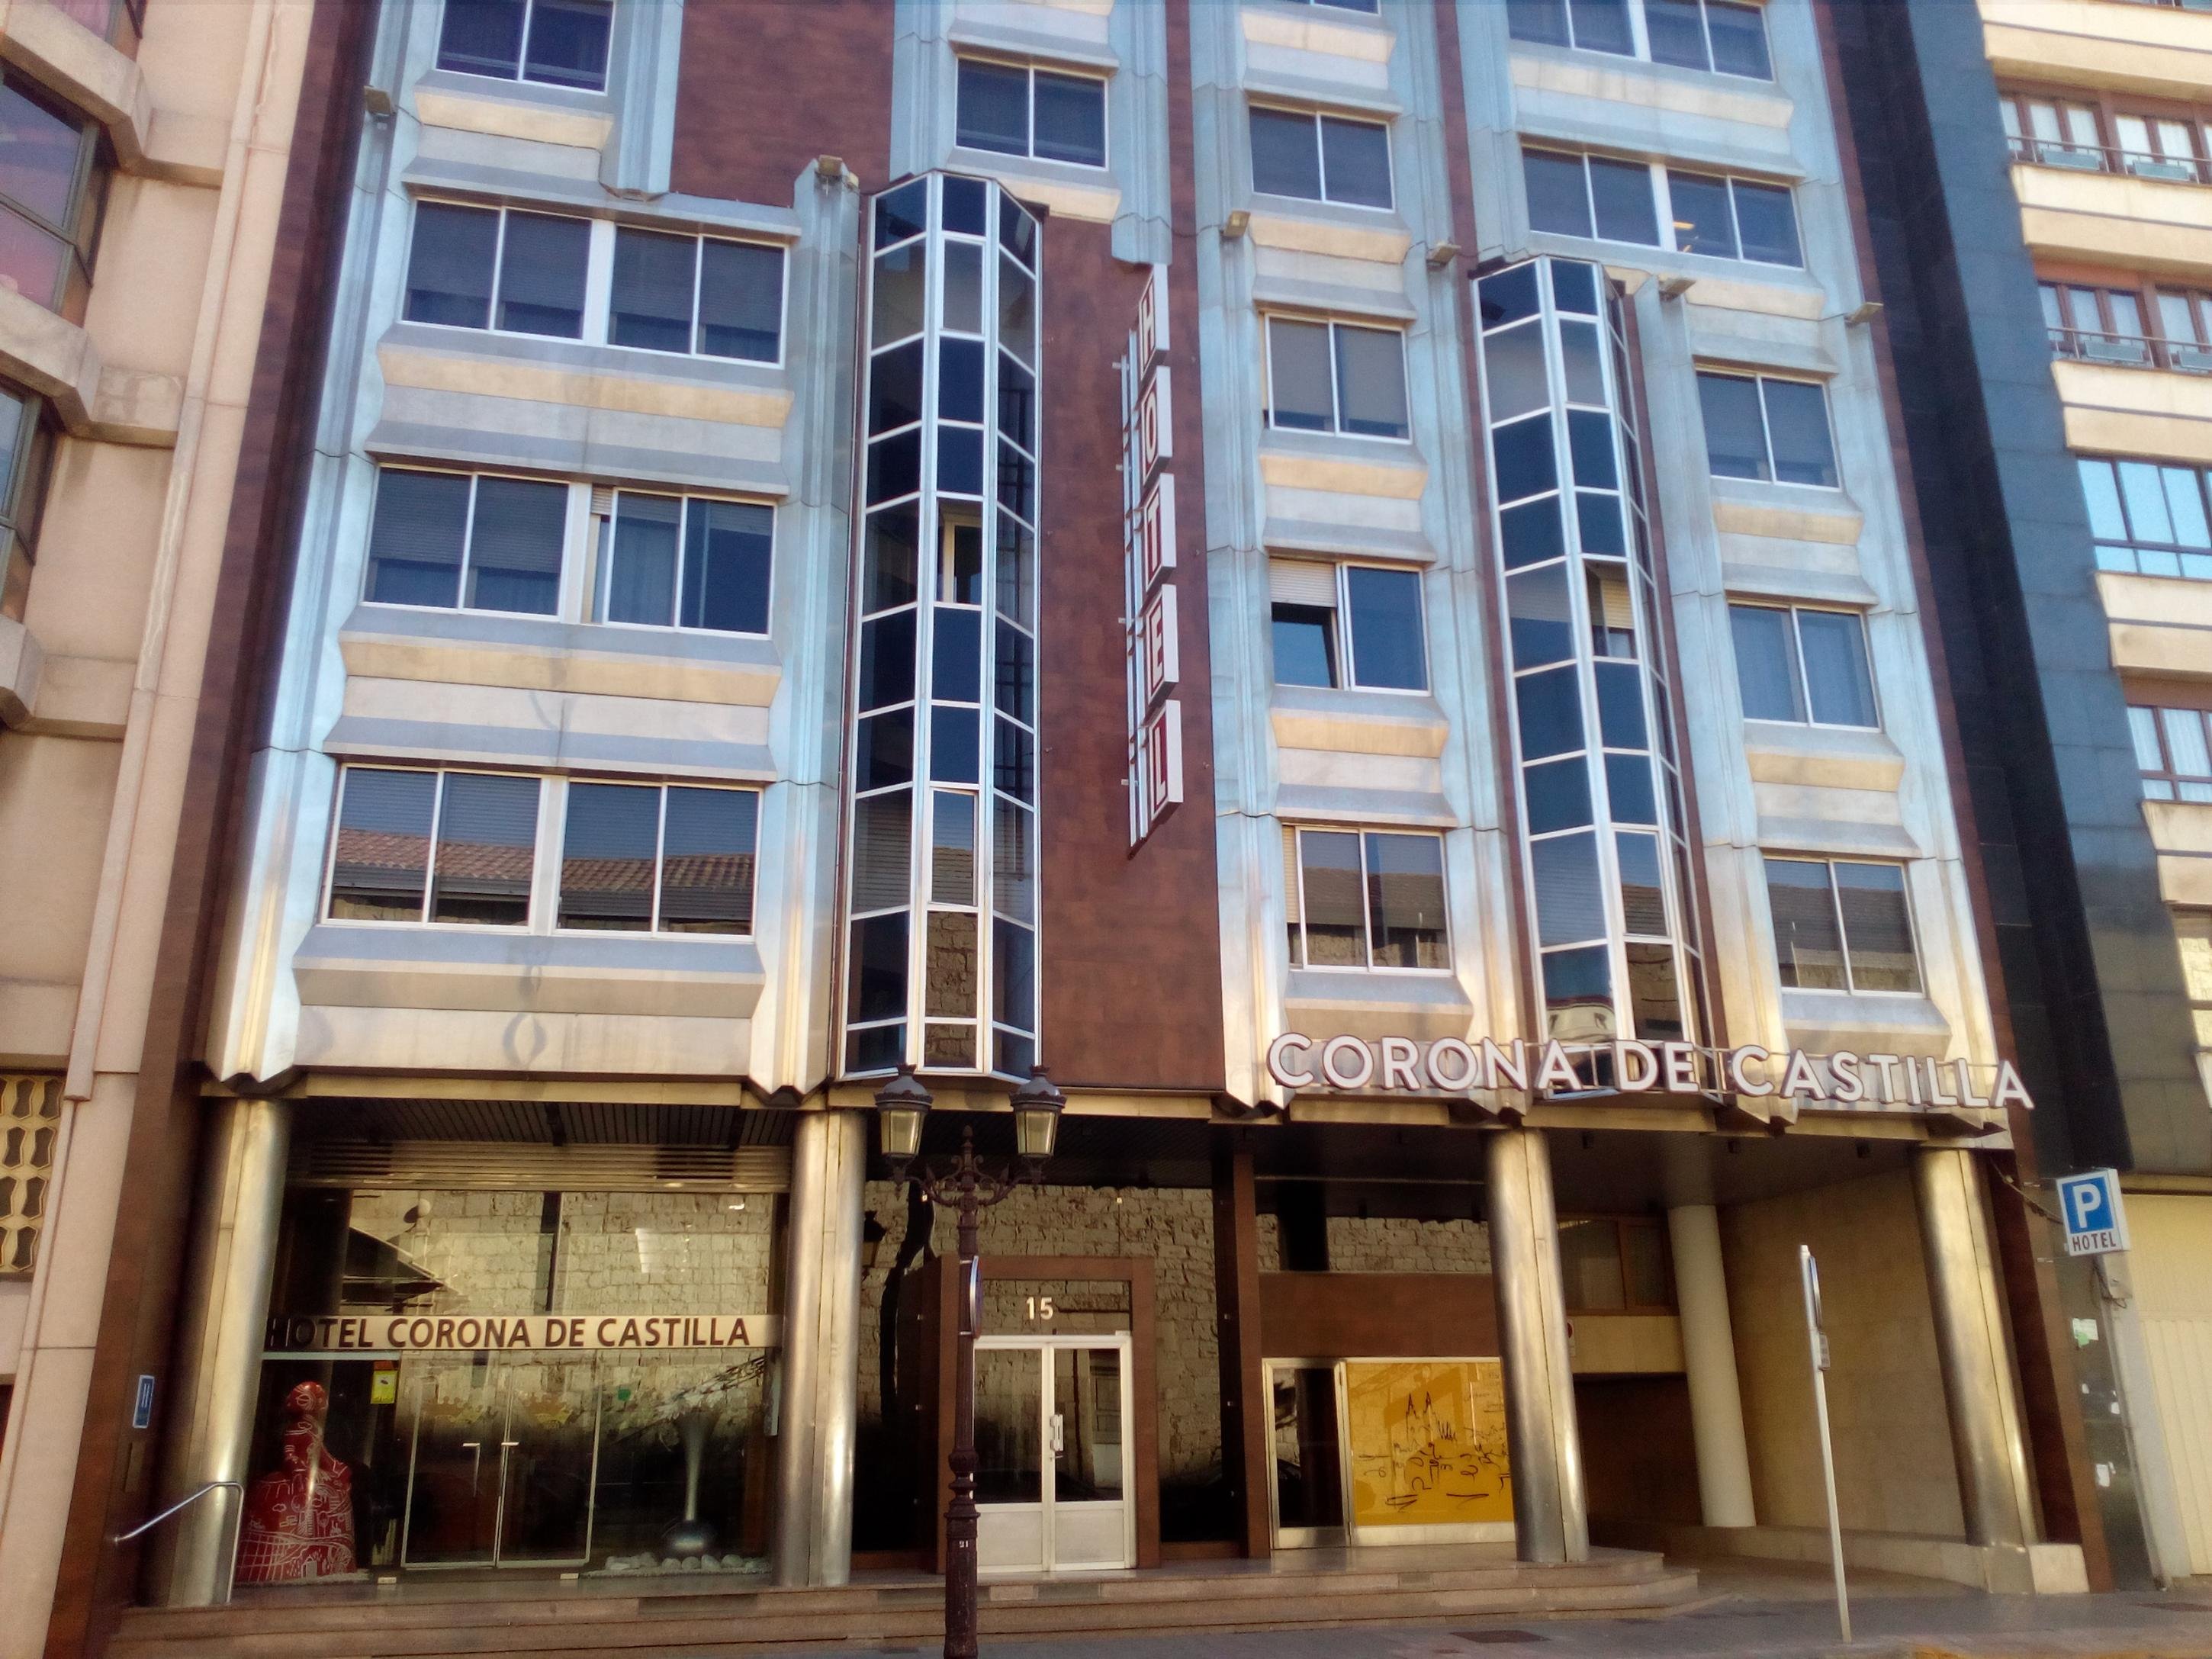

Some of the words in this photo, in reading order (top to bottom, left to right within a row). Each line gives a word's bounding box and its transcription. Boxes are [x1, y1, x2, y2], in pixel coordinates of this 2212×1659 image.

[1140, 275, 1171, 810] HOTEL
[1266, 1031, 1582, 1091] CORONA
[1612, 1039, 1700, 1093] DE
[1729, 1044, 2034, 1109] CASTILLA
[2072, 1183, 2101, 1228] P
[2072, 1232, 2117, 1252] HOTEL
[1026, 1296, 1053, 1320] 15
[387, 1317, 532, 1349] CORONA
[545, 1317, 586, 1348] DE
[597, 1317, 751, 1347] CASTILLA
